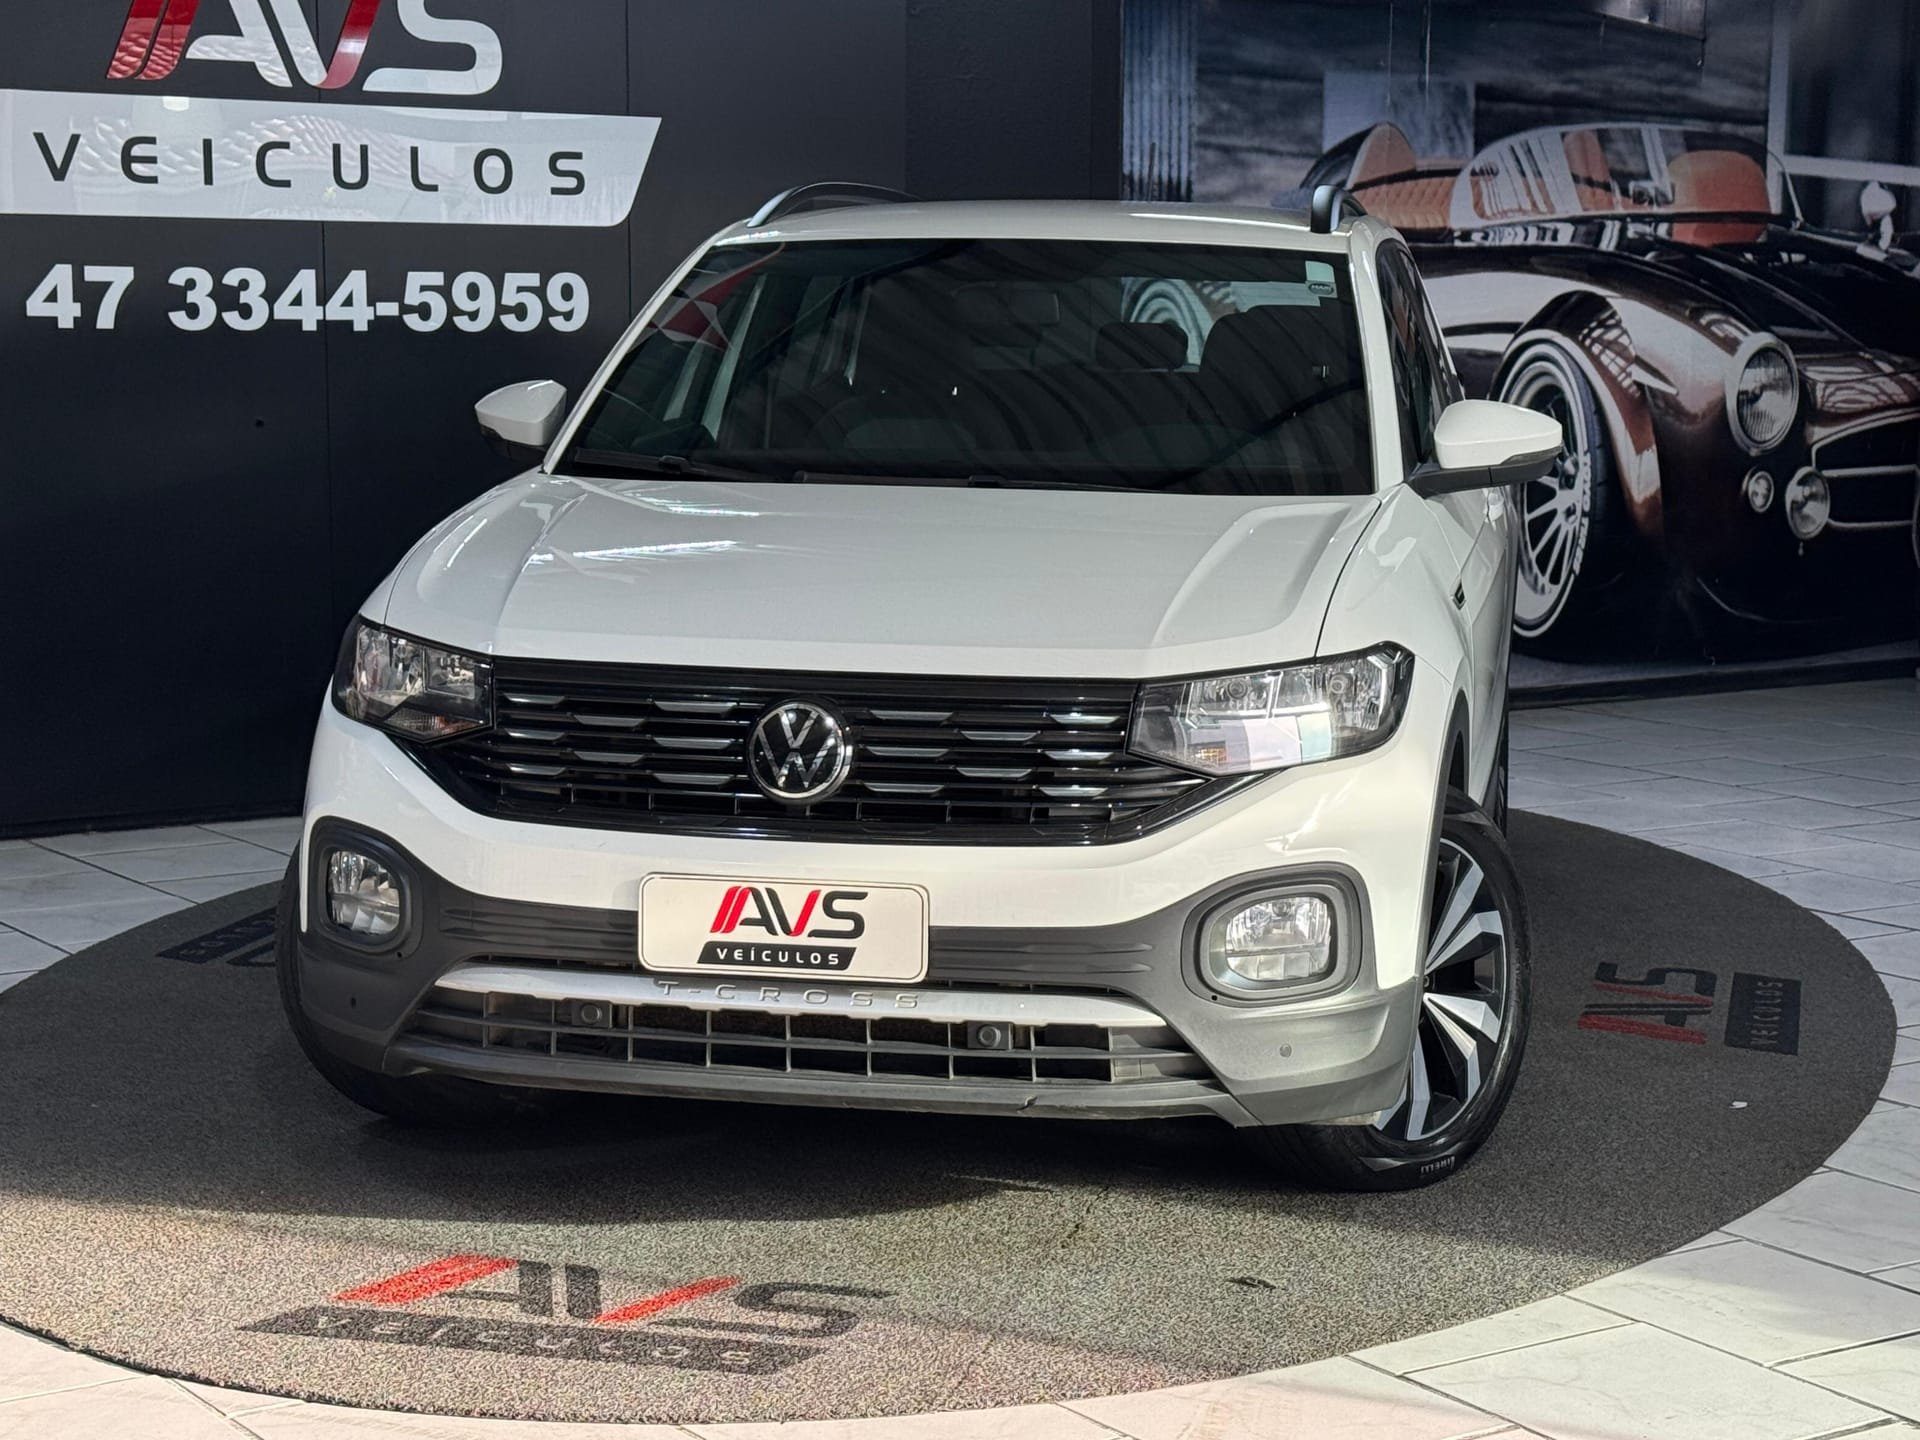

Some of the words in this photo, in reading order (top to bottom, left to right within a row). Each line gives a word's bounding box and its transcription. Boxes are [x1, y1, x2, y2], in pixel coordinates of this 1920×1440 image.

[26, 263, 135, 329] 47
[168, 266, 590, 332] 3344-5959
[709, 885, 868, 940] AVS
[716, 946, 840, 966] VEÍCULOS
[657, 980, 919, 1009] T-CROSS
[332, 1254, 892, 1339] AVS
